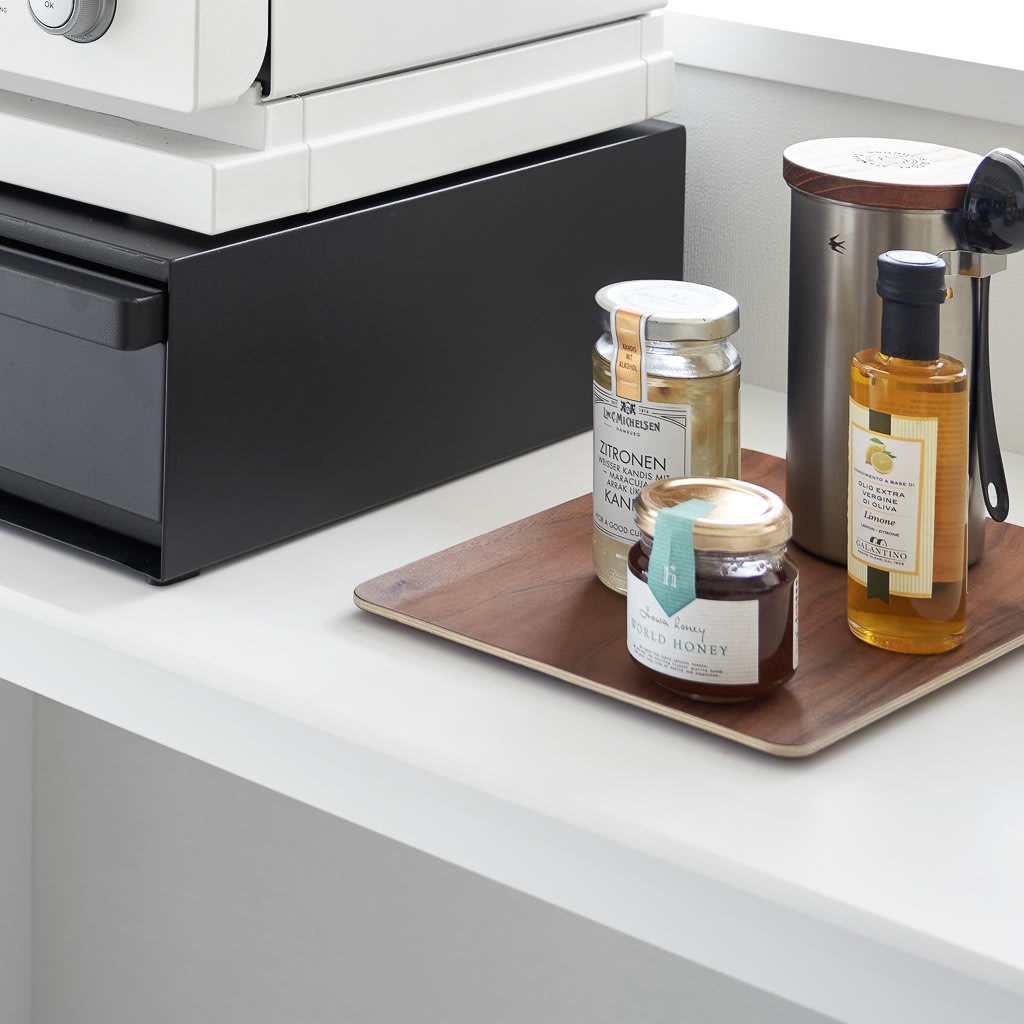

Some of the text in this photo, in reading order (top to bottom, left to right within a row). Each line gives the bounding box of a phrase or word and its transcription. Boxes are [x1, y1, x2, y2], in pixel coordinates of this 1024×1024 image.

[44, 0, 55, 10] OK
[616, 412, 661, 432] MICHELSEN
[616, 427, 641, 437] HAMBURG
[599, 439, 666, 471] ZITRONEN
[598, 456, 621, 472] WEISSER
[622, 466, 653, 481] KANDIS
[607, 479, 628, 493] ARRAK
[609, 471, 649, 488] MARACUJA
[890, 479, 906, 487] BASE
[858, 480, 906, 498] OLIO EXTRA
[862, 490, 898, 505] VERGINE
[604, 488, 636, 512] KAN
[862, 498, 897, 513] DI OLIVA
[863, 510, 896, 527] Limone
[608, 521, 628, 534] GOOD
[856, 539, 908, 561] GALANTINO
[631, 617, 666, 645] WORLD
[673, 638, 728, 657] HONEY
